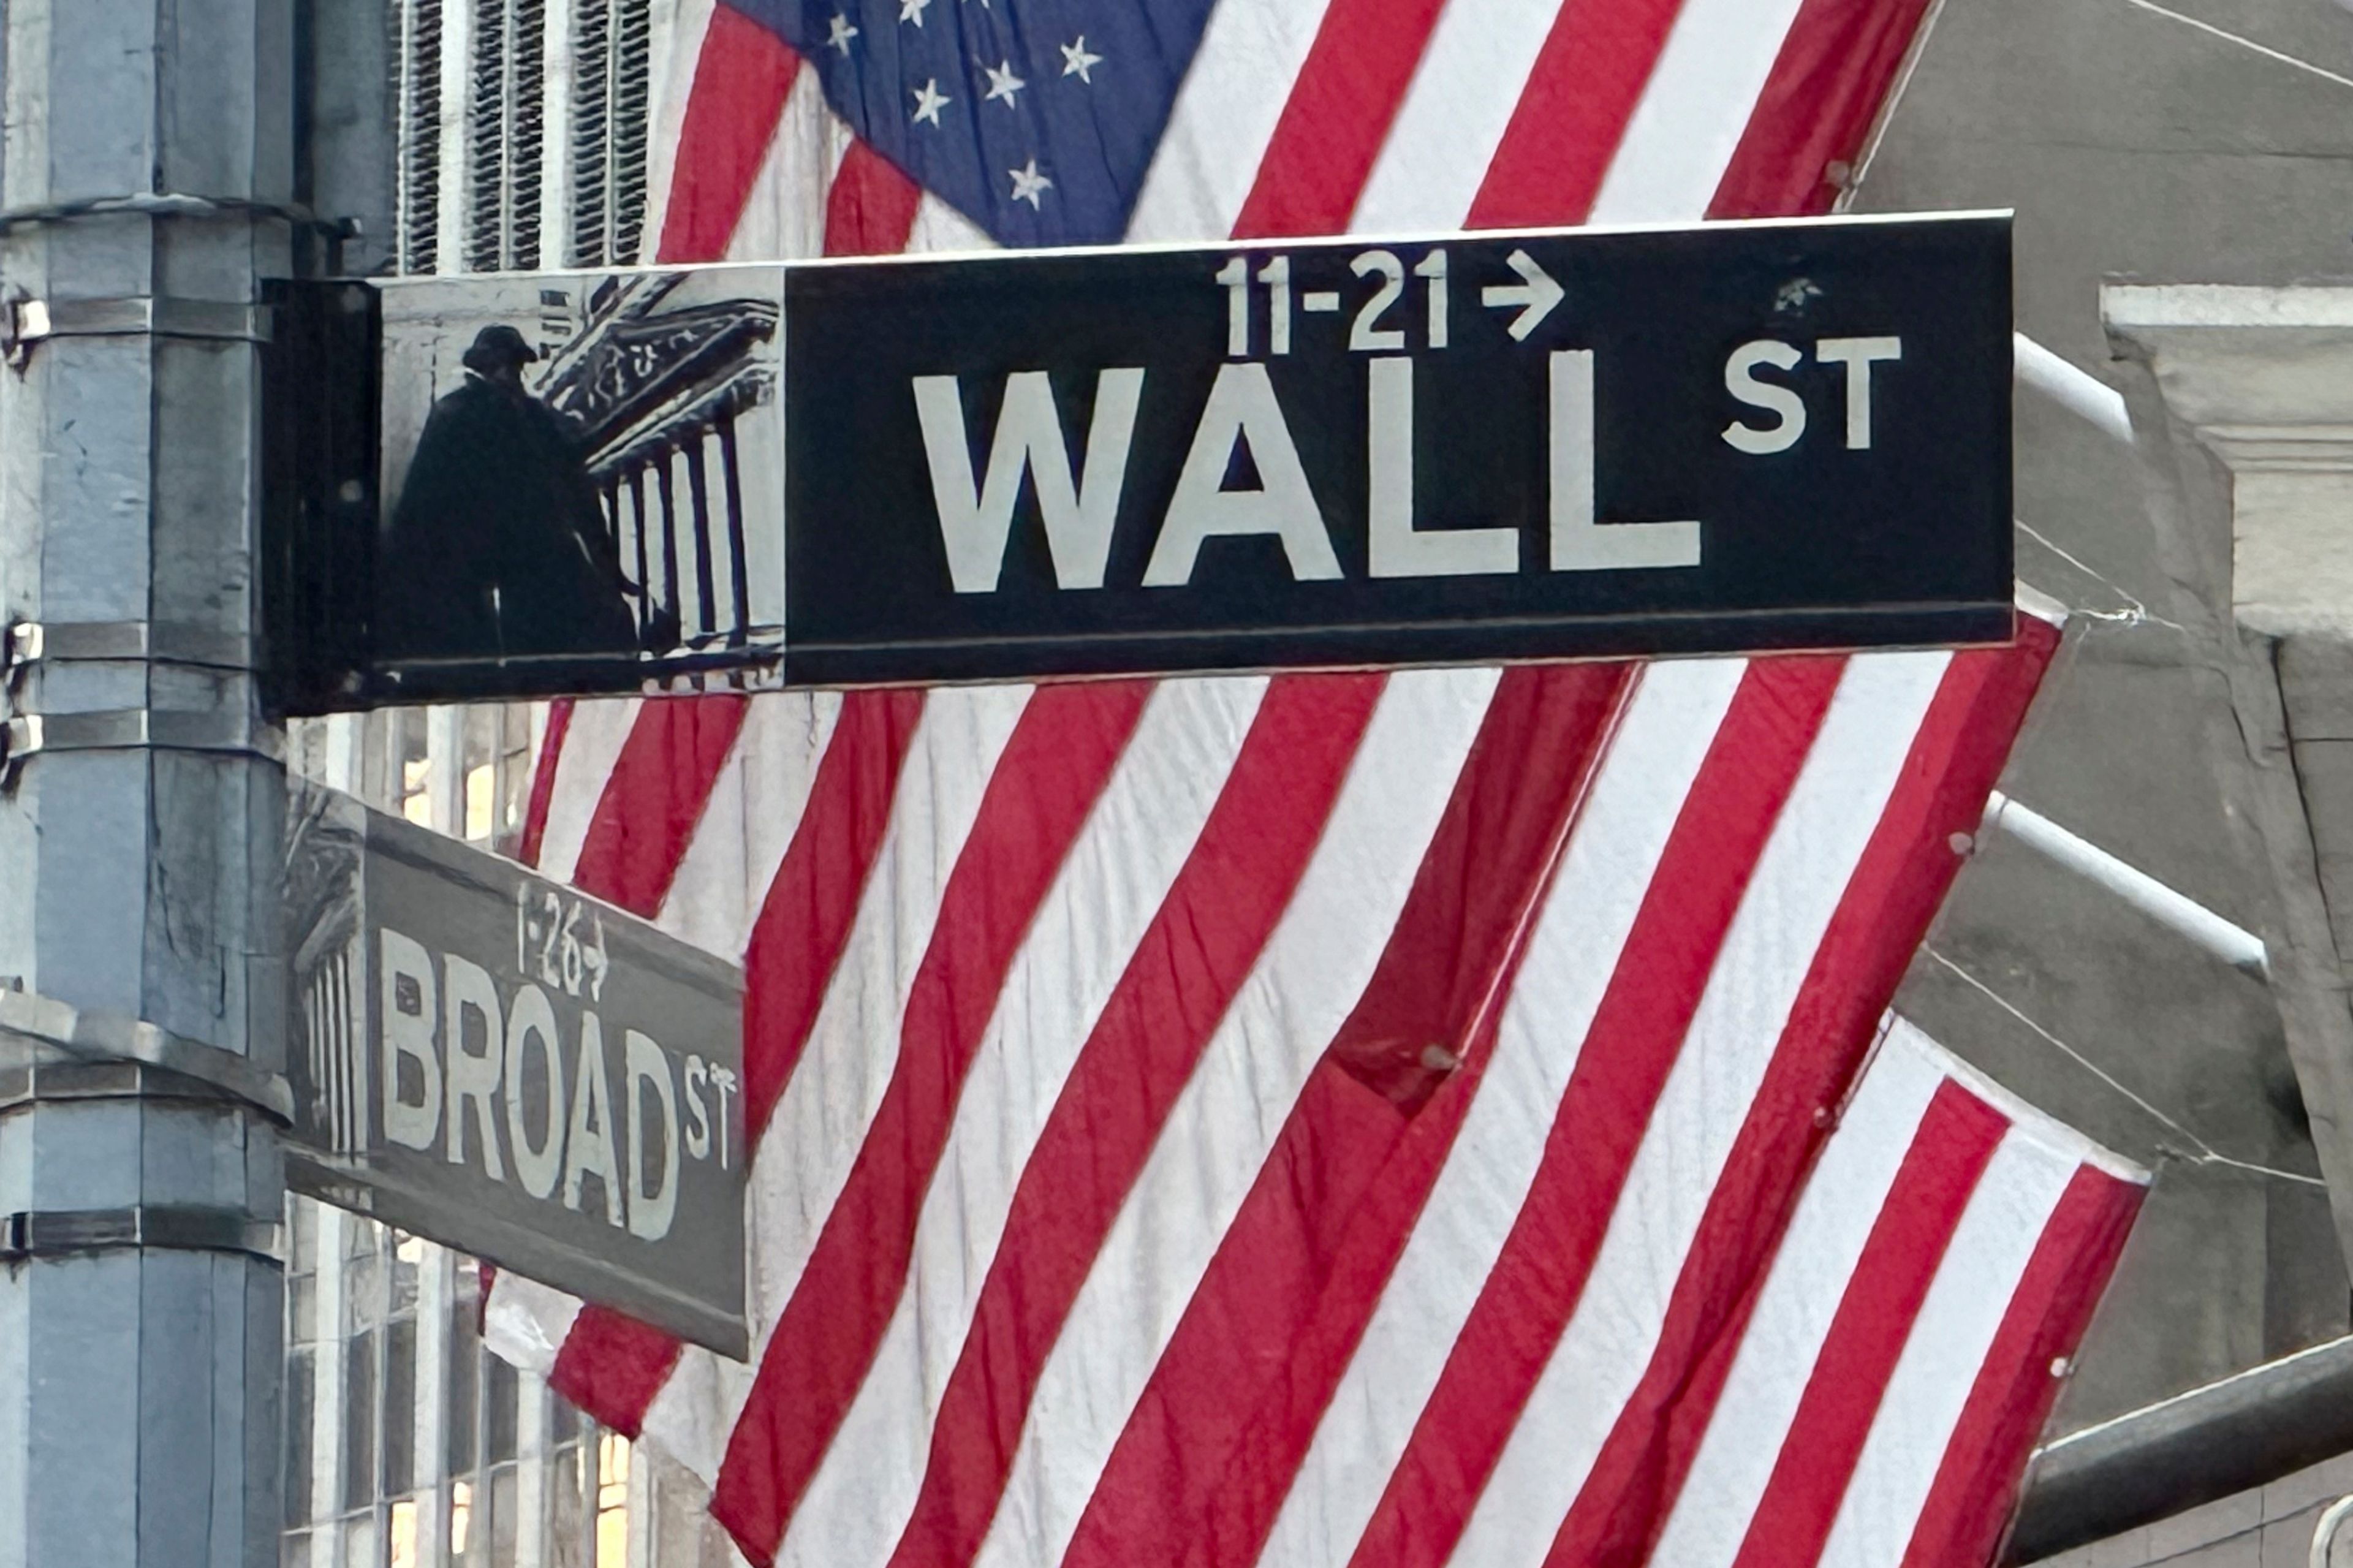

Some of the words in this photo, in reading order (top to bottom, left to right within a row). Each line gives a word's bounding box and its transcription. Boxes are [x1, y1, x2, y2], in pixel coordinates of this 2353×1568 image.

[1216, 249, 1448, 356] 11-21
[913, 349, 1702, 594] WALL
[1721, 337, 1902, 454] ST
[518, 881, 583, 997] 1-26
[381, 928, 680, 1241] BROAD
[684, 1055, 738, 1170] ST
